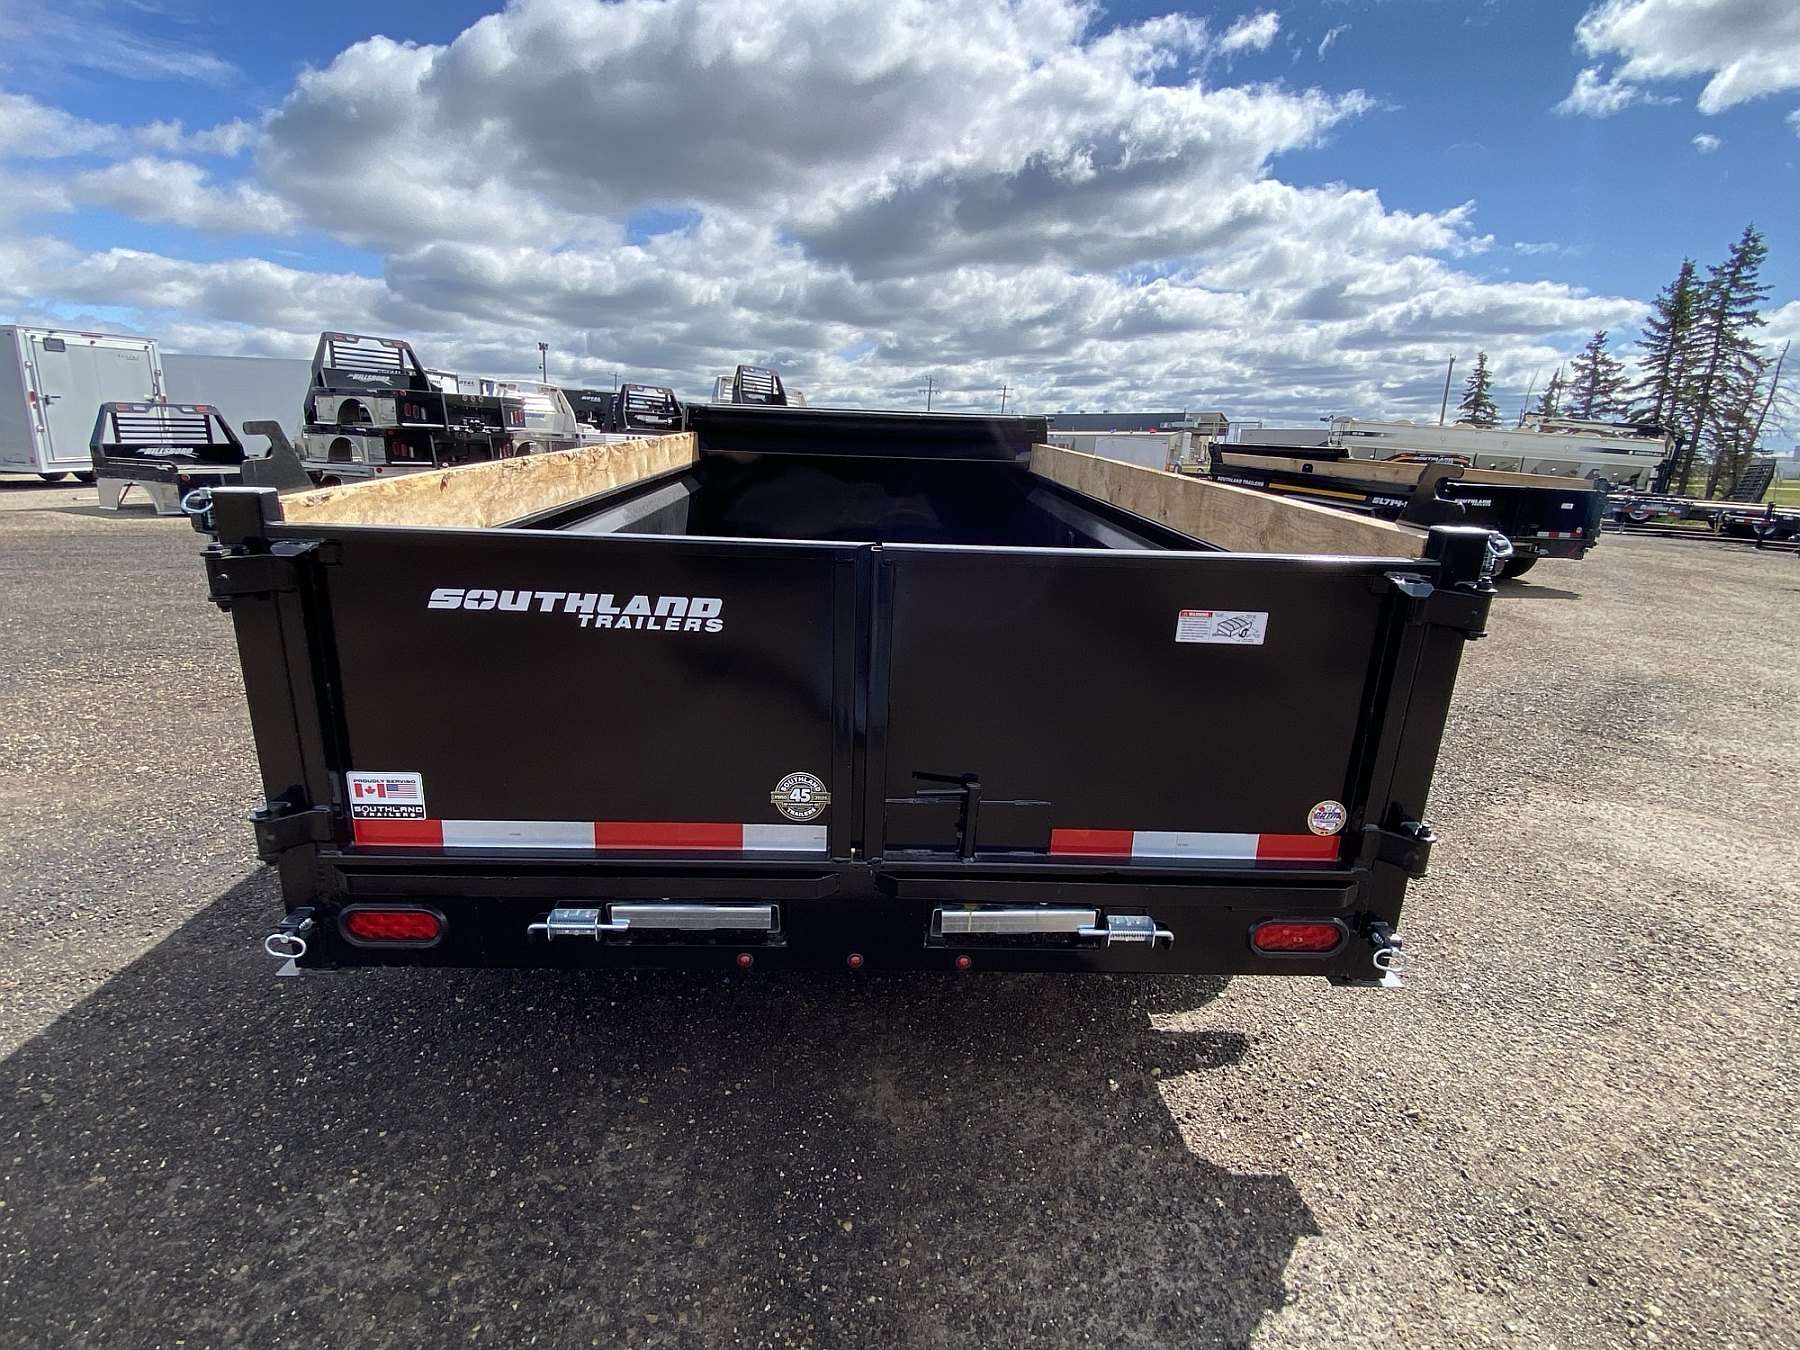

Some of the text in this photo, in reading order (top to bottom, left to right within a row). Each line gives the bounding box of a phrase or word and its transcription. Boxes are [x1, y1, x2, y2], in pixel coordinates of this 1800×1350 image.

[143, 447, 194, 457] HILLSBORO
[427, 588, 723, 618] SOUTHLAND
[578, 614, 724, 633] TRAILERS
[780, 776, 821, 792] SOUTHLAND
[789, 788, 811, 803] 45
[353, 805, 423, 813] SOUTHLAND
